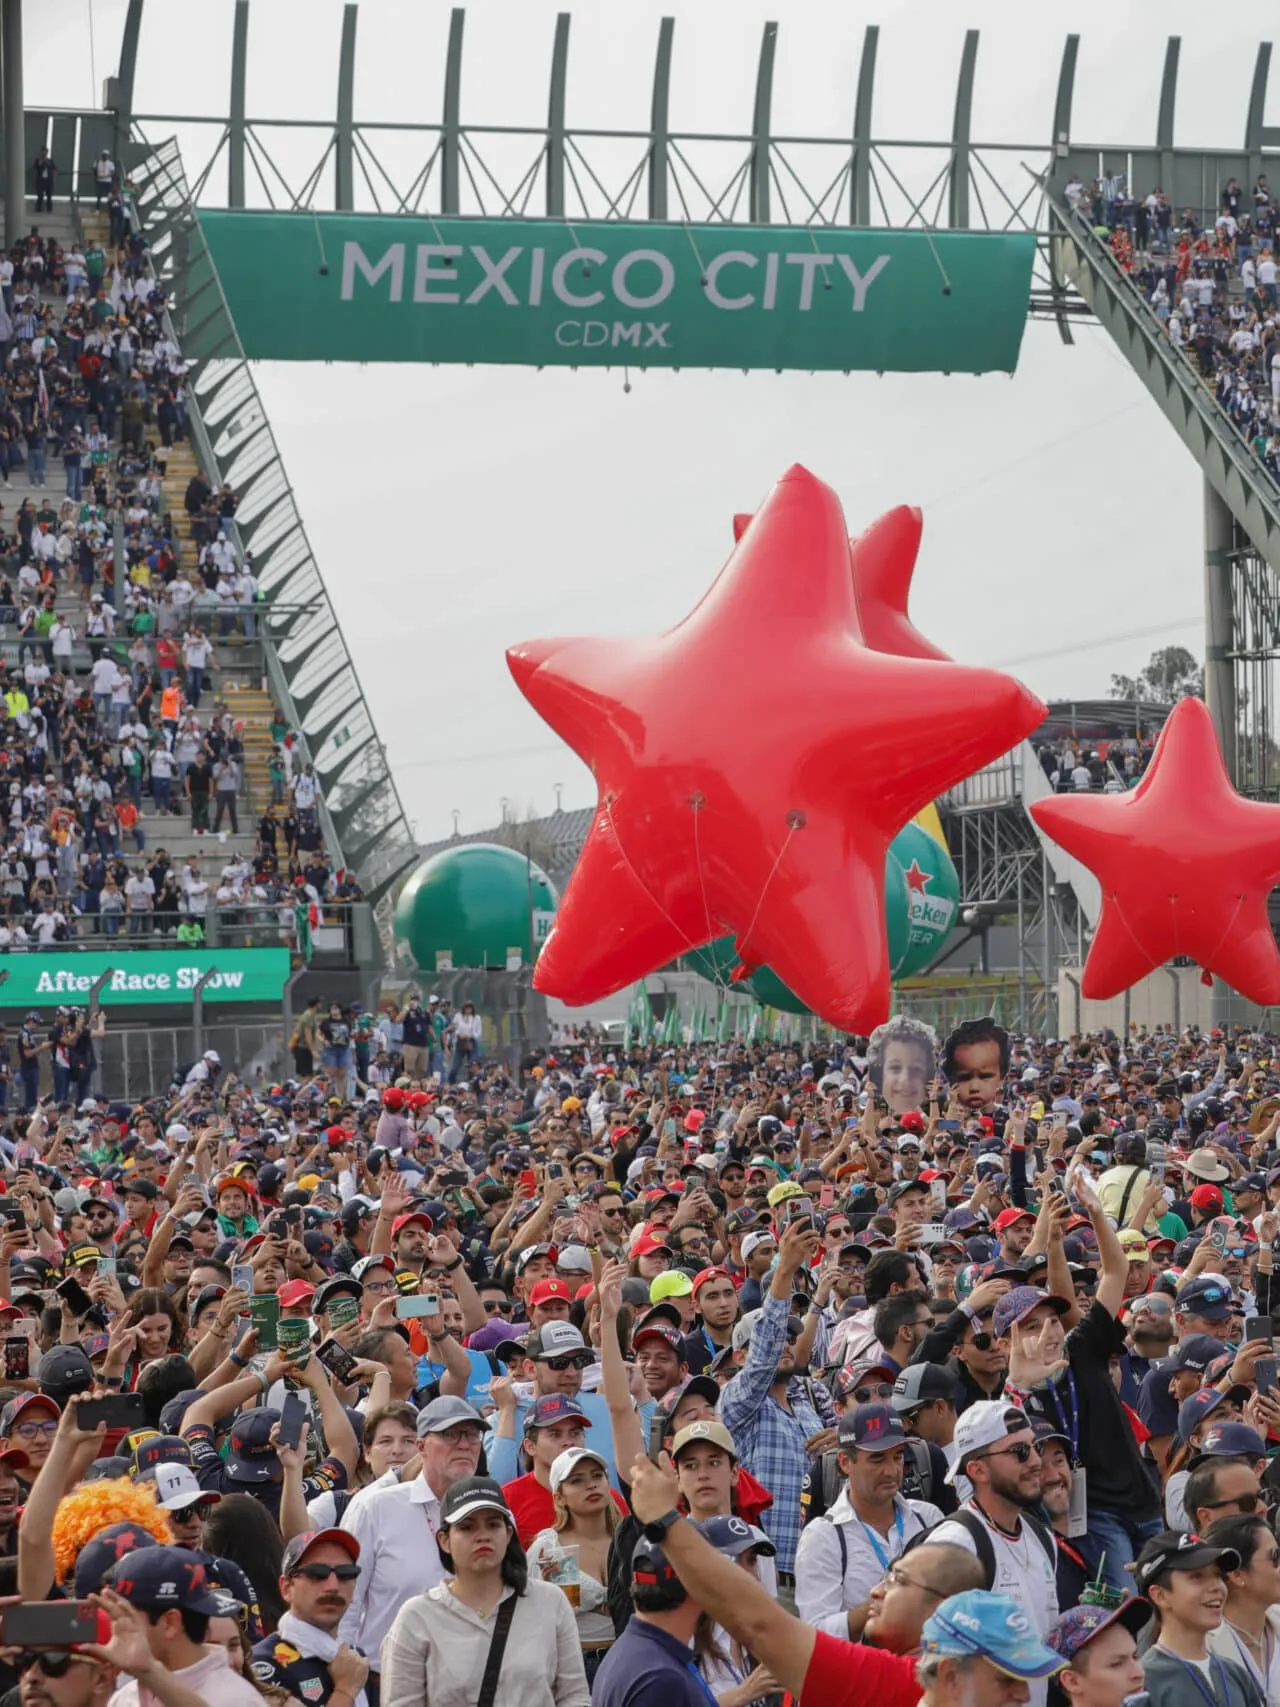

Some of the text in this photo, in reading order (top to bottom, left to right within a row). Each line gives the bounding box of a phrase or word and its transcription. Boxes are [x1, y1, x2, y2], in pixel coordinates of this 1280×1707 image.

[341, 241, 892, 311] MEXICO CITY
[554, 320, 671, 347] CDMX
[110, 969, 171, 991] Race
[176, 967, 244, 989] Show
[866, 1418, 881, 1433] 11
[167, 1476, 182, 1489] 11
